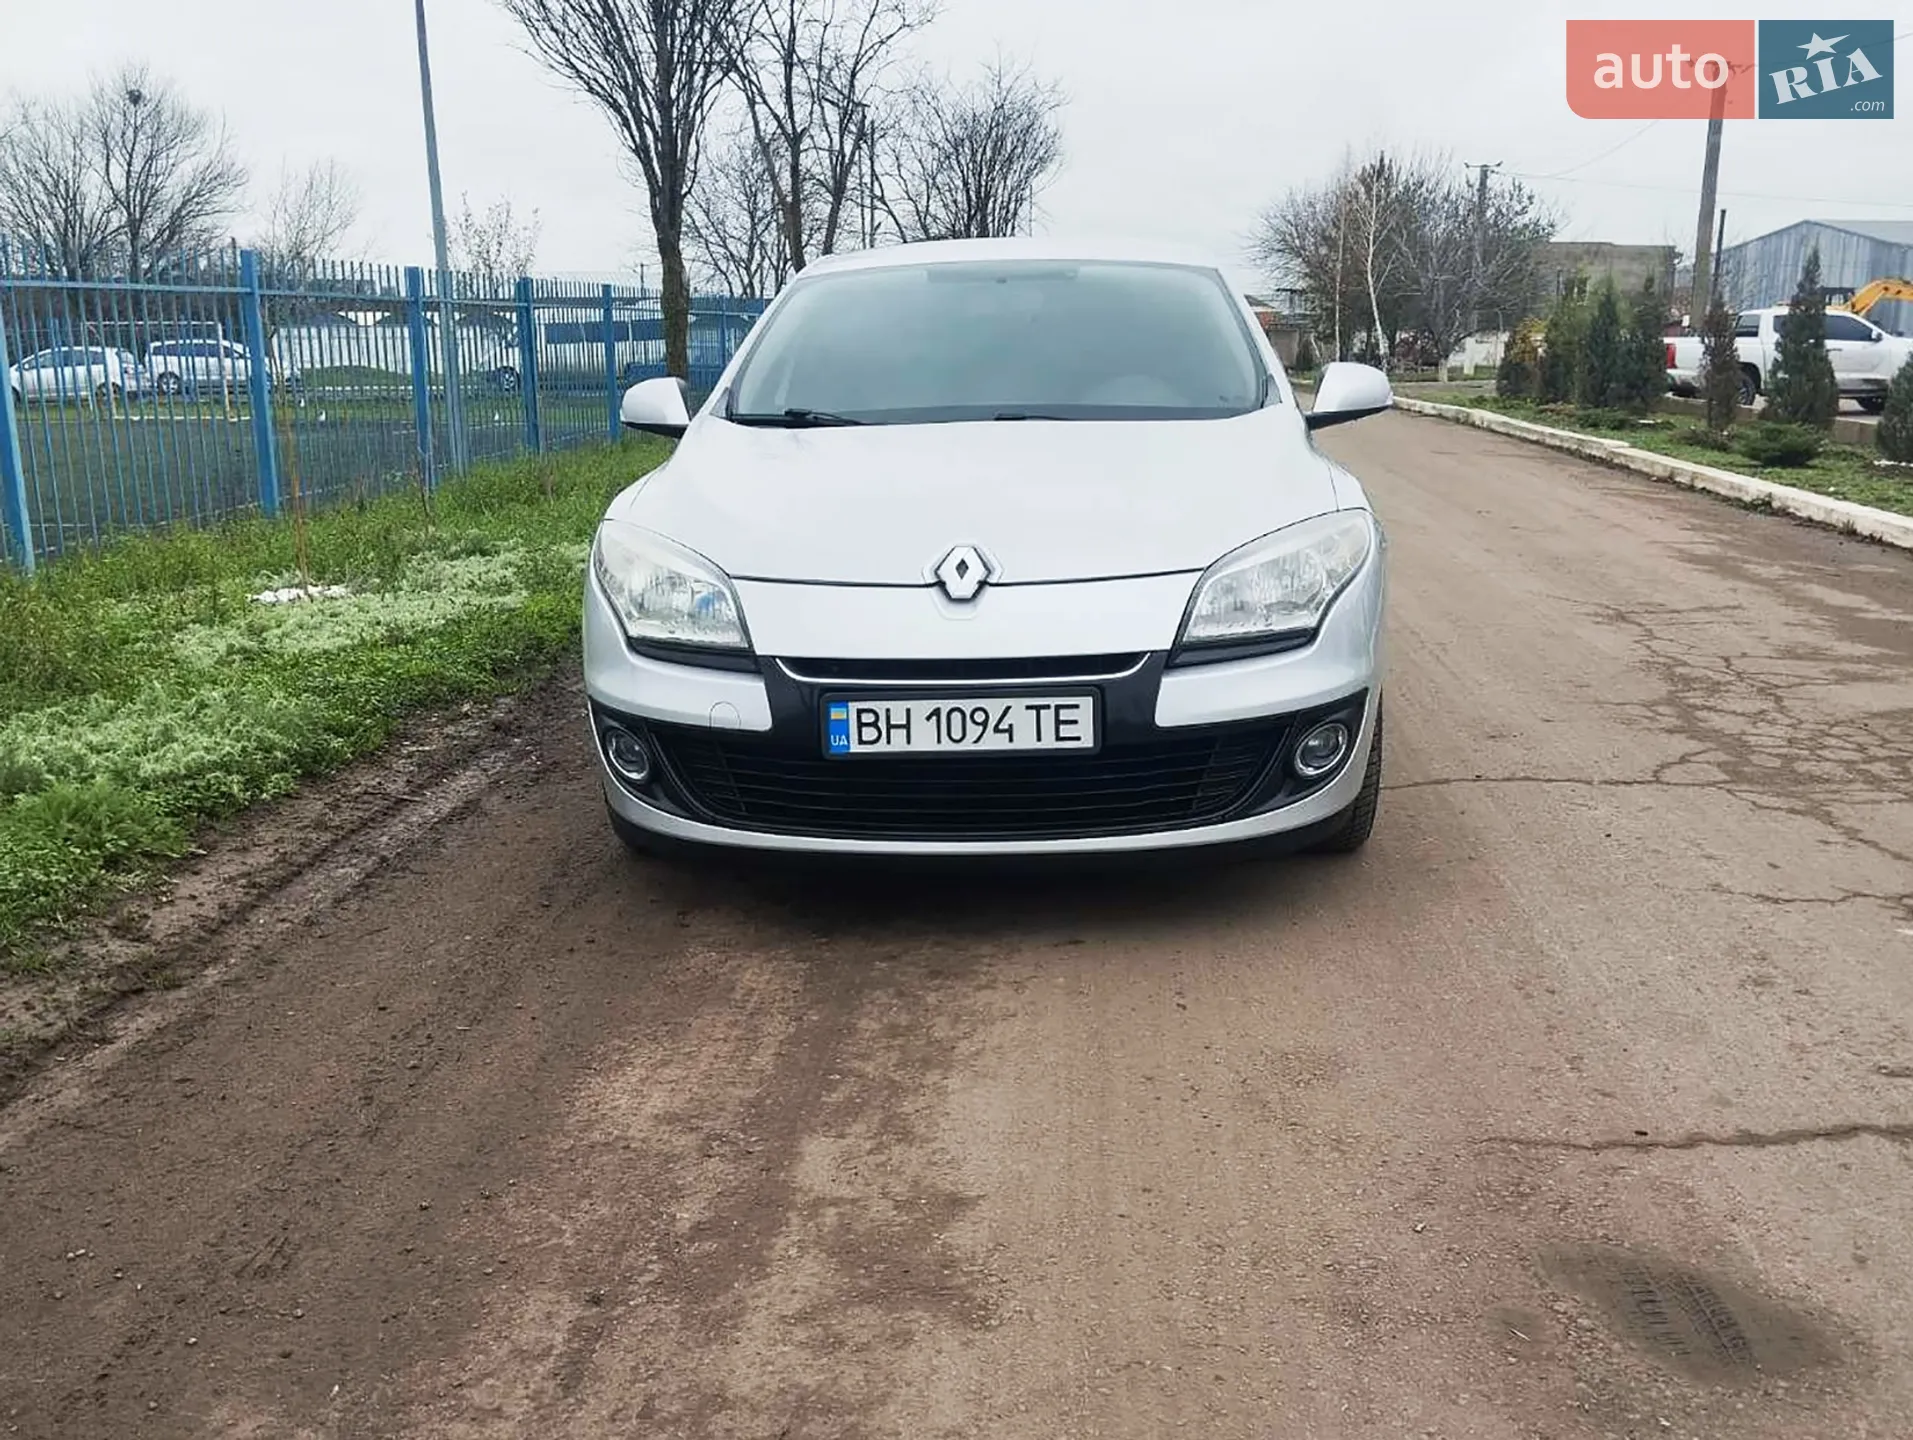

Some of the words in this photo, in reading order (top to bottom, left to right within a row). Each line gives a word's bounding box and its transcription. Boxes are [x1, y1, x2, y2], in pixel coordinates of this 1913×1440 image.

[856, 707, 911, 745] BH
[925, 705, 1014, 745] 1094
[1025, 703, 1082, 743] TE
[830, 735, 848, 746] UA
